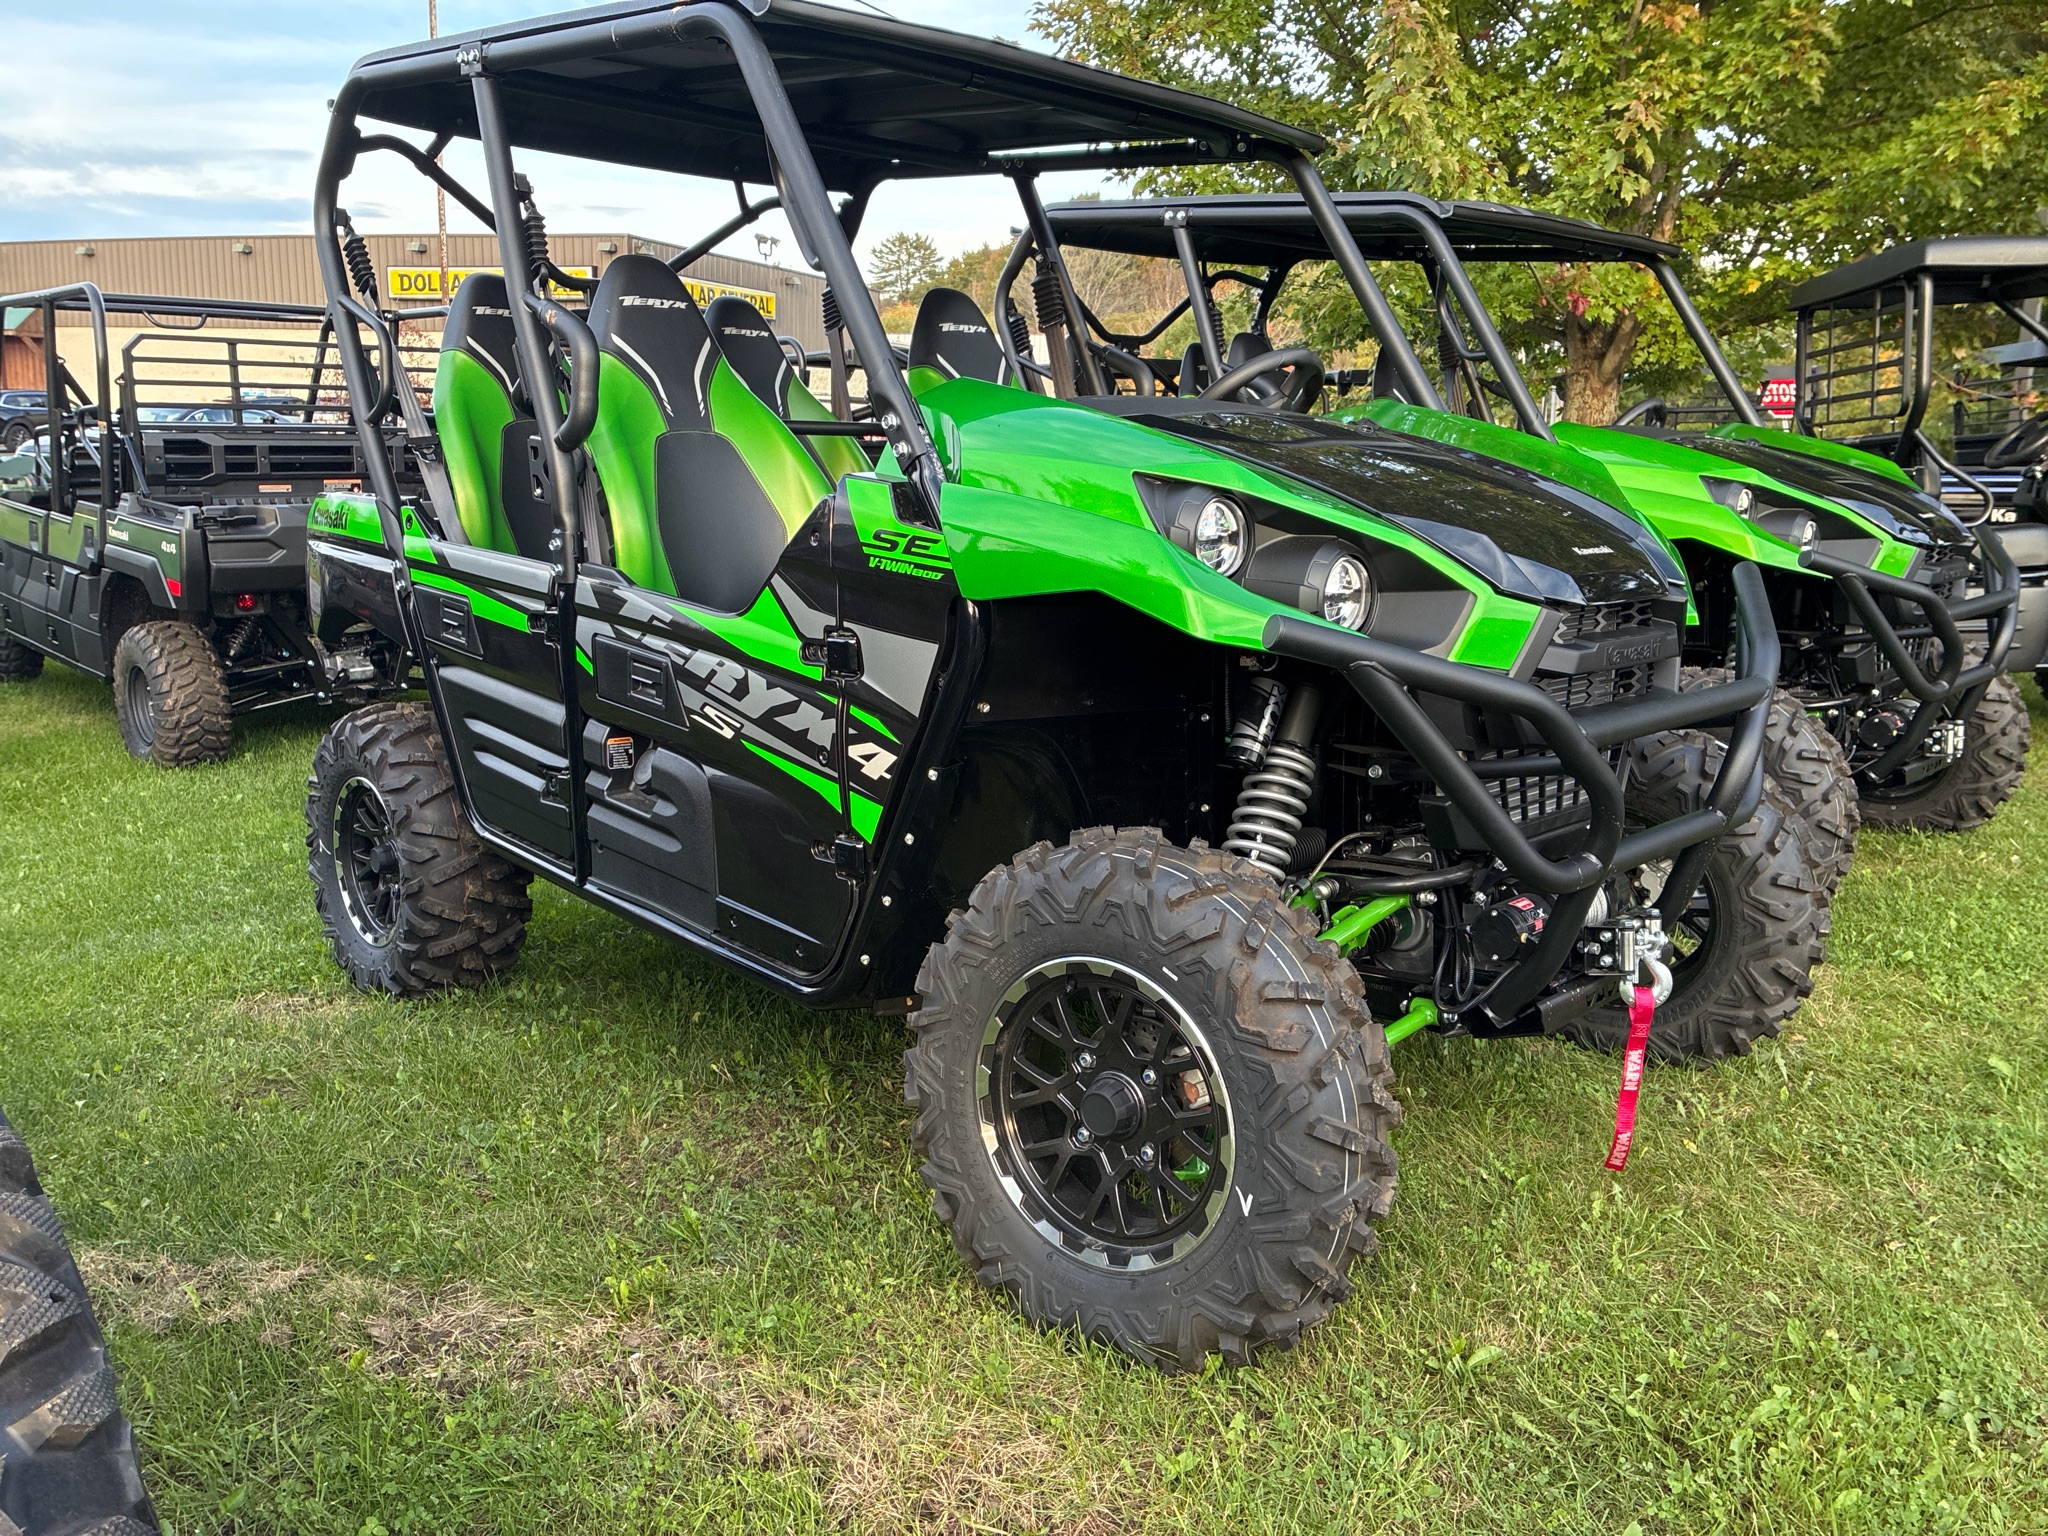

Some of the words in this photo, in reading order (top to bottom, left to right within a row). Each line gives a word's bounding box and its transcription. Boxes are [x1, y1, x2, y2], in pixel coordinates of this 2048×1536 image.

[398, 273, 471, 292] DOLA
[310, 501, 350, 531] Kawasaki
[1990, 508, 2017, 523] Ka
[160, 540, 177, 555] 4x4
[872, 529, 942, 558] SE
[1623, 1048, 1644, 1091] WARN
[1610, 1131, 1632, 1167] WARN
